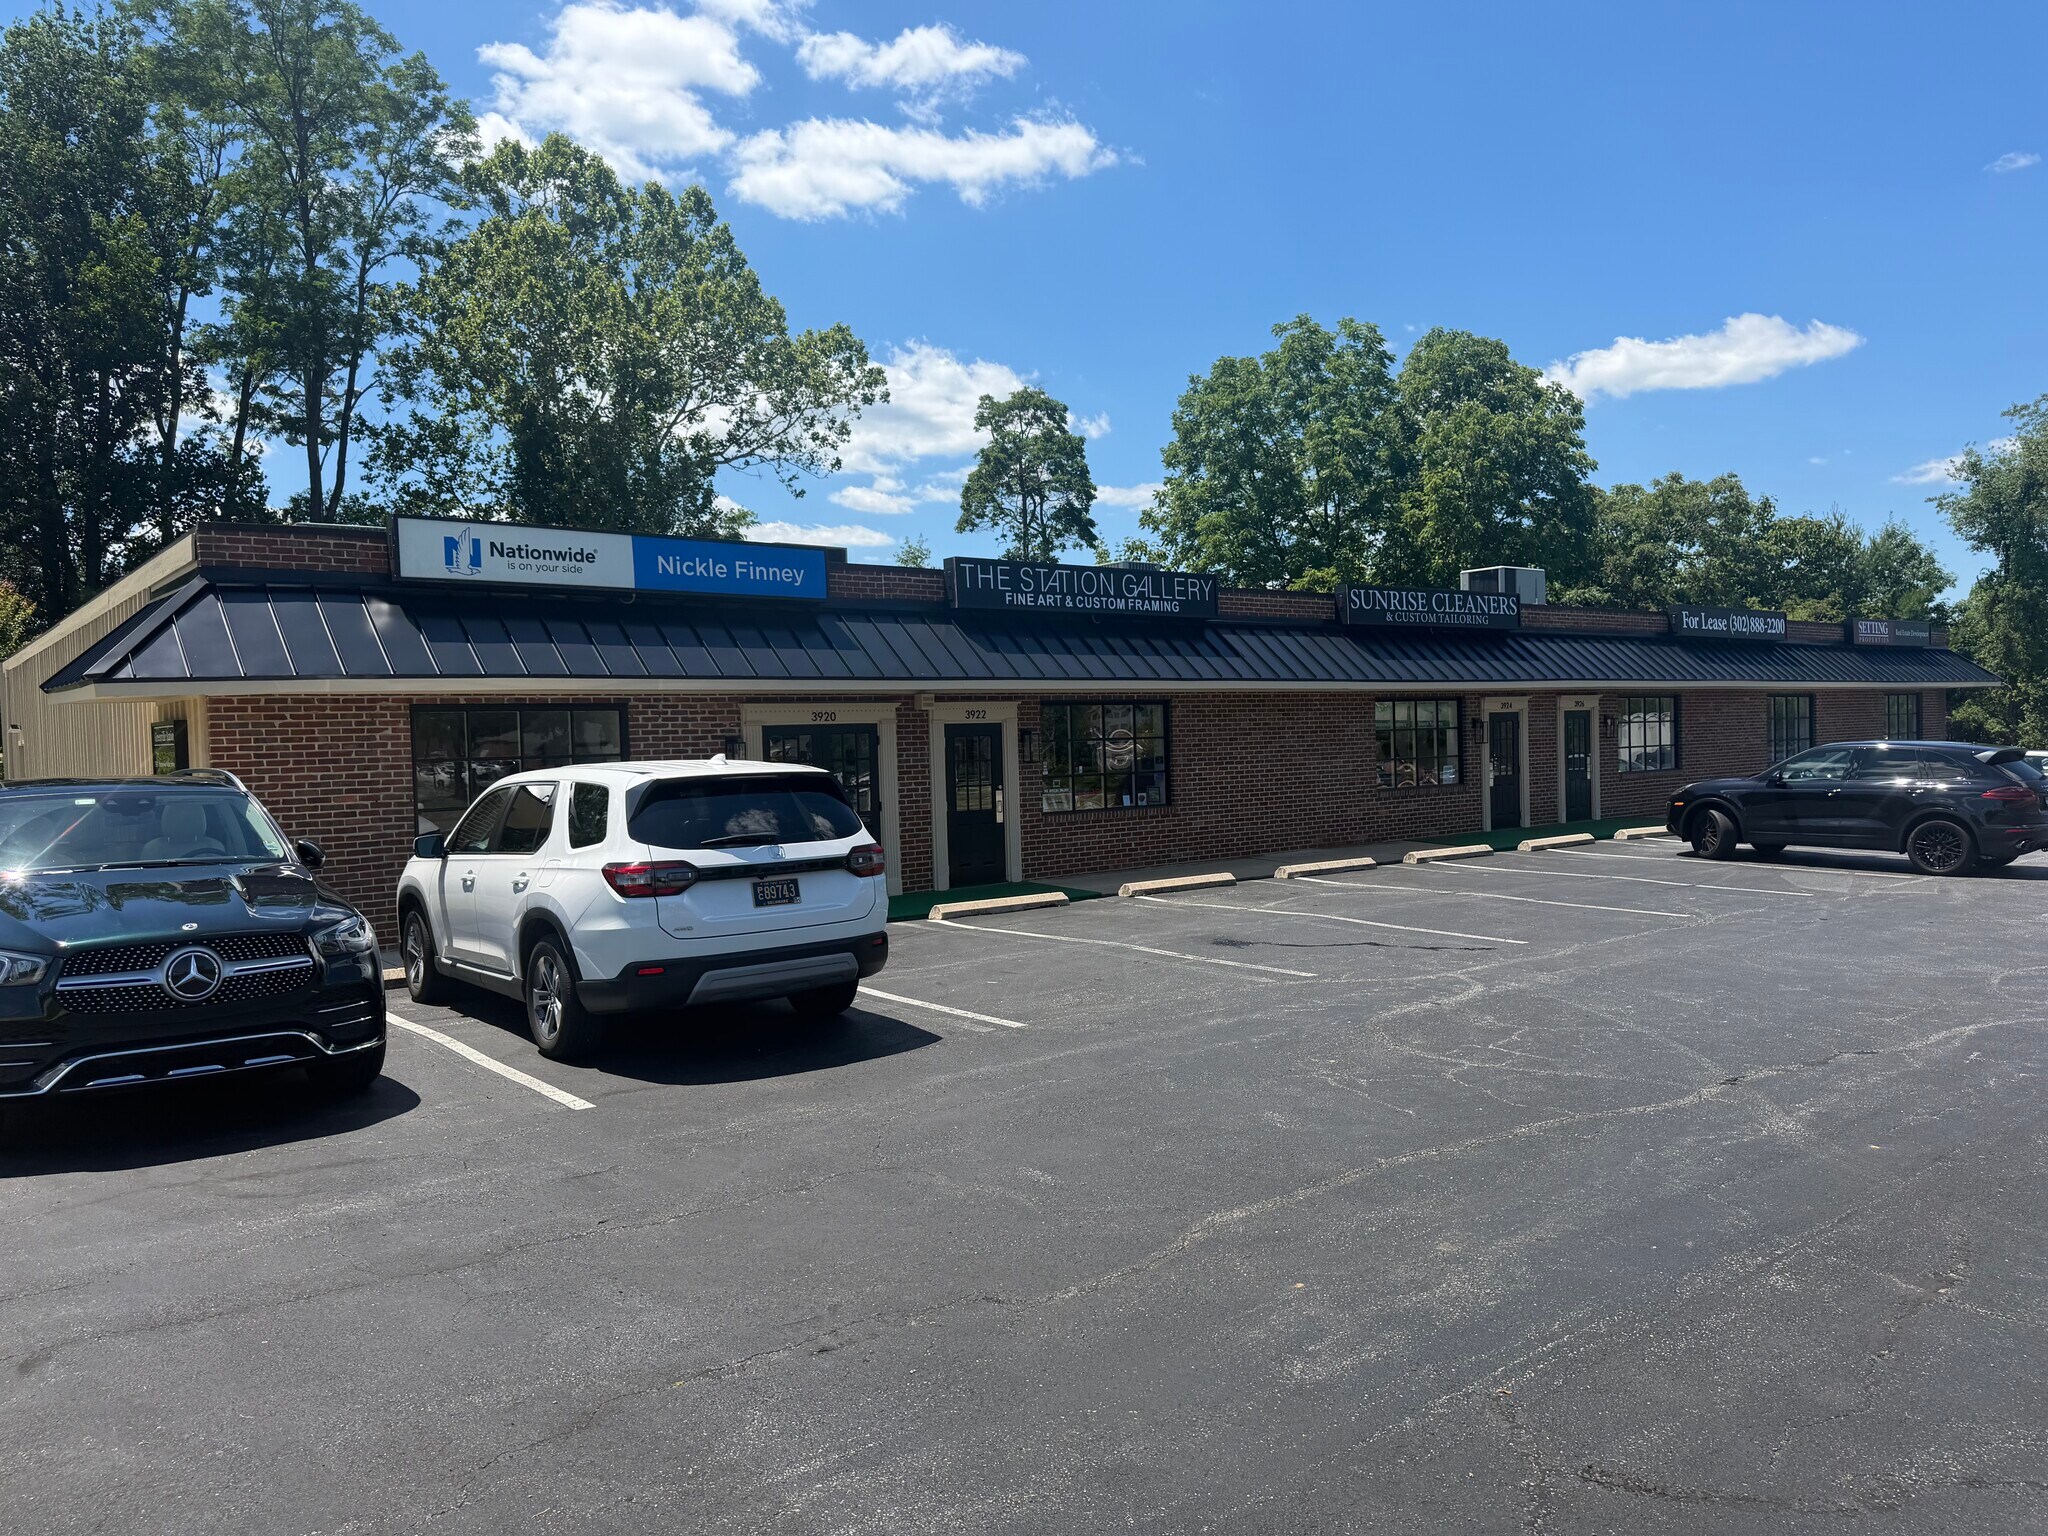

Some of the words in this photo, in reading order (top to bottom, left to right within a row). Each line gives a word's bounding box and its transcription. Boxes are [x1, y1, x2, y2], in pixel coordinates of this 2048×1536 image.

[507, 561, 517, 571] is
[520, 563, 533, 573] on
[535, 563, 558, 574] your
[561, 564, 583, 573] side
[657, 555, 728, 579] Nickle
[735, 561, 804, 586] Finney
[960, 564, 1011, 590] THE
[1021, 567, 1114, 596] STATION
[1123, 574, 1213, 601] GALLERY
[1005, 593, 1035, 606] FINE
[1037, 594, 1062, 607] ART
[1065, 596, 1074, 608] &
[1077, 596, 1126, 610] CUSTOM
[1128, 599, 1180, 612] FRAMING
[1350, 588, 1428, 611] SUNRISE
[1432, 593, 1517, 616] CLEANERS
[1386, 612, 1393, 622] &
[1395, 612, 1437, 623] CUSTOM
[1438, 614, 1489, 625] TAILORING
[1682, 611, 1699, 629] For
[1701, 612, 1727, 631] Lease
[1729, 613, 1750, 635] (302)
[1750, 616, 1785, 634] 888-2200
[1858, 621, 1888, 635] SETTING
[1500, 702, 1513, 710] 3924
[811, 711, 837, 722] 3920
[965, 710, 987, 720] 3922
[764, 884, 796, 899] 89743
